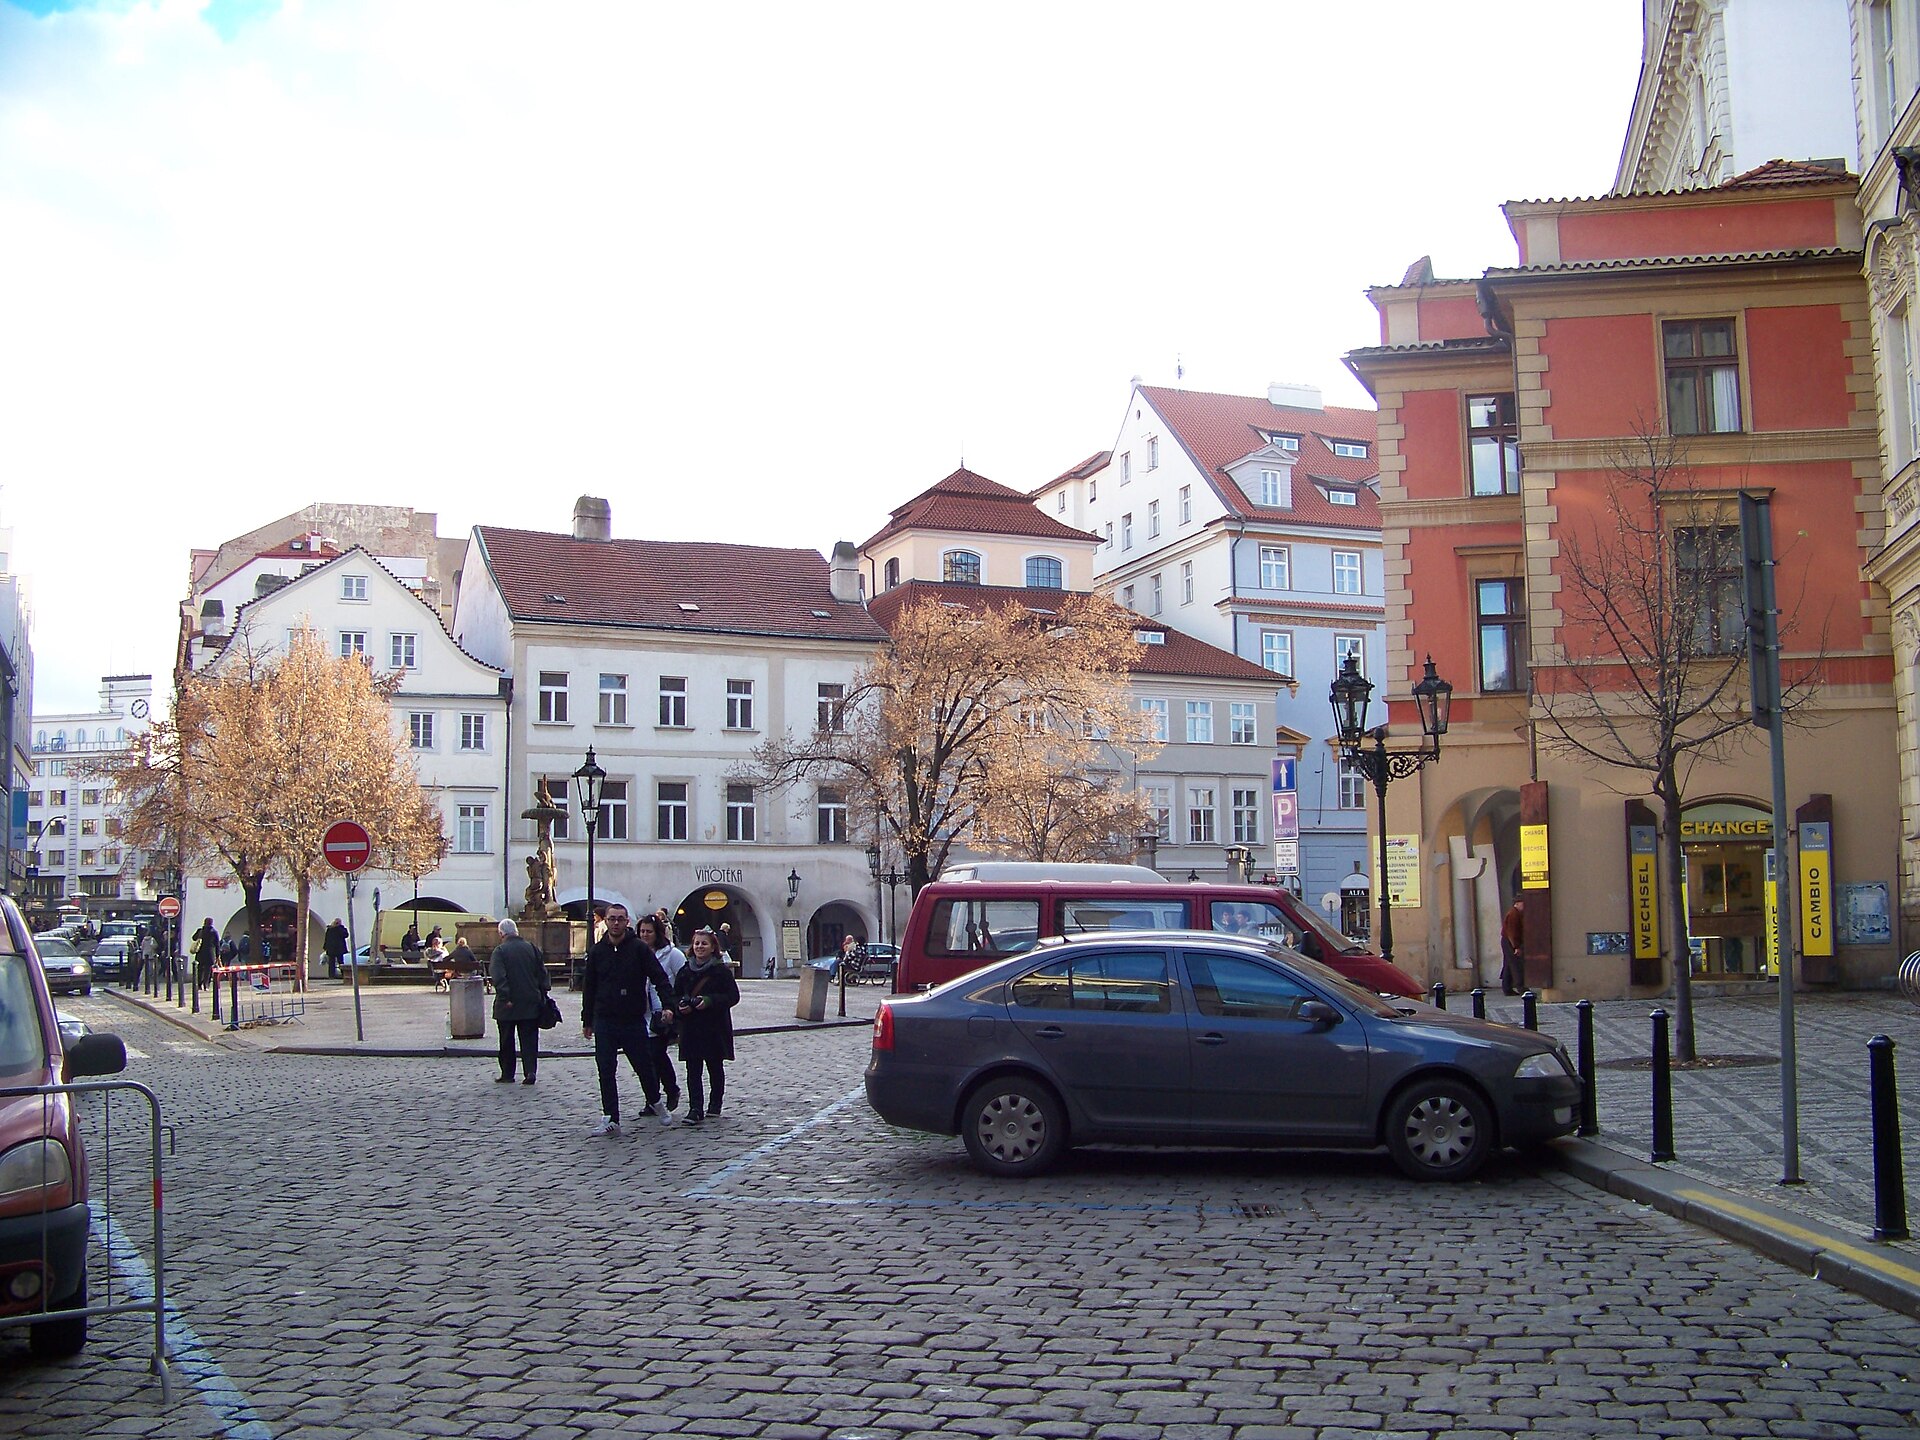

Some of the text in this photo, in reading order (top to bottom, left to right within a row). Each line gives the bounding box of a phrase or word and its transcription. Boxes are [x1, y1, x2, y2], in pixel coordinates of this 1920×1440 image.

[1277, 798, 1292, 826] P
[1680, 820, 1769, 835] CHANGE
[695, 868, 743, 883] VINOTÉKA
[1639, 862, 1652, 950] WECHSEL
[1809, 867, 1822, 938] CAMBIO
